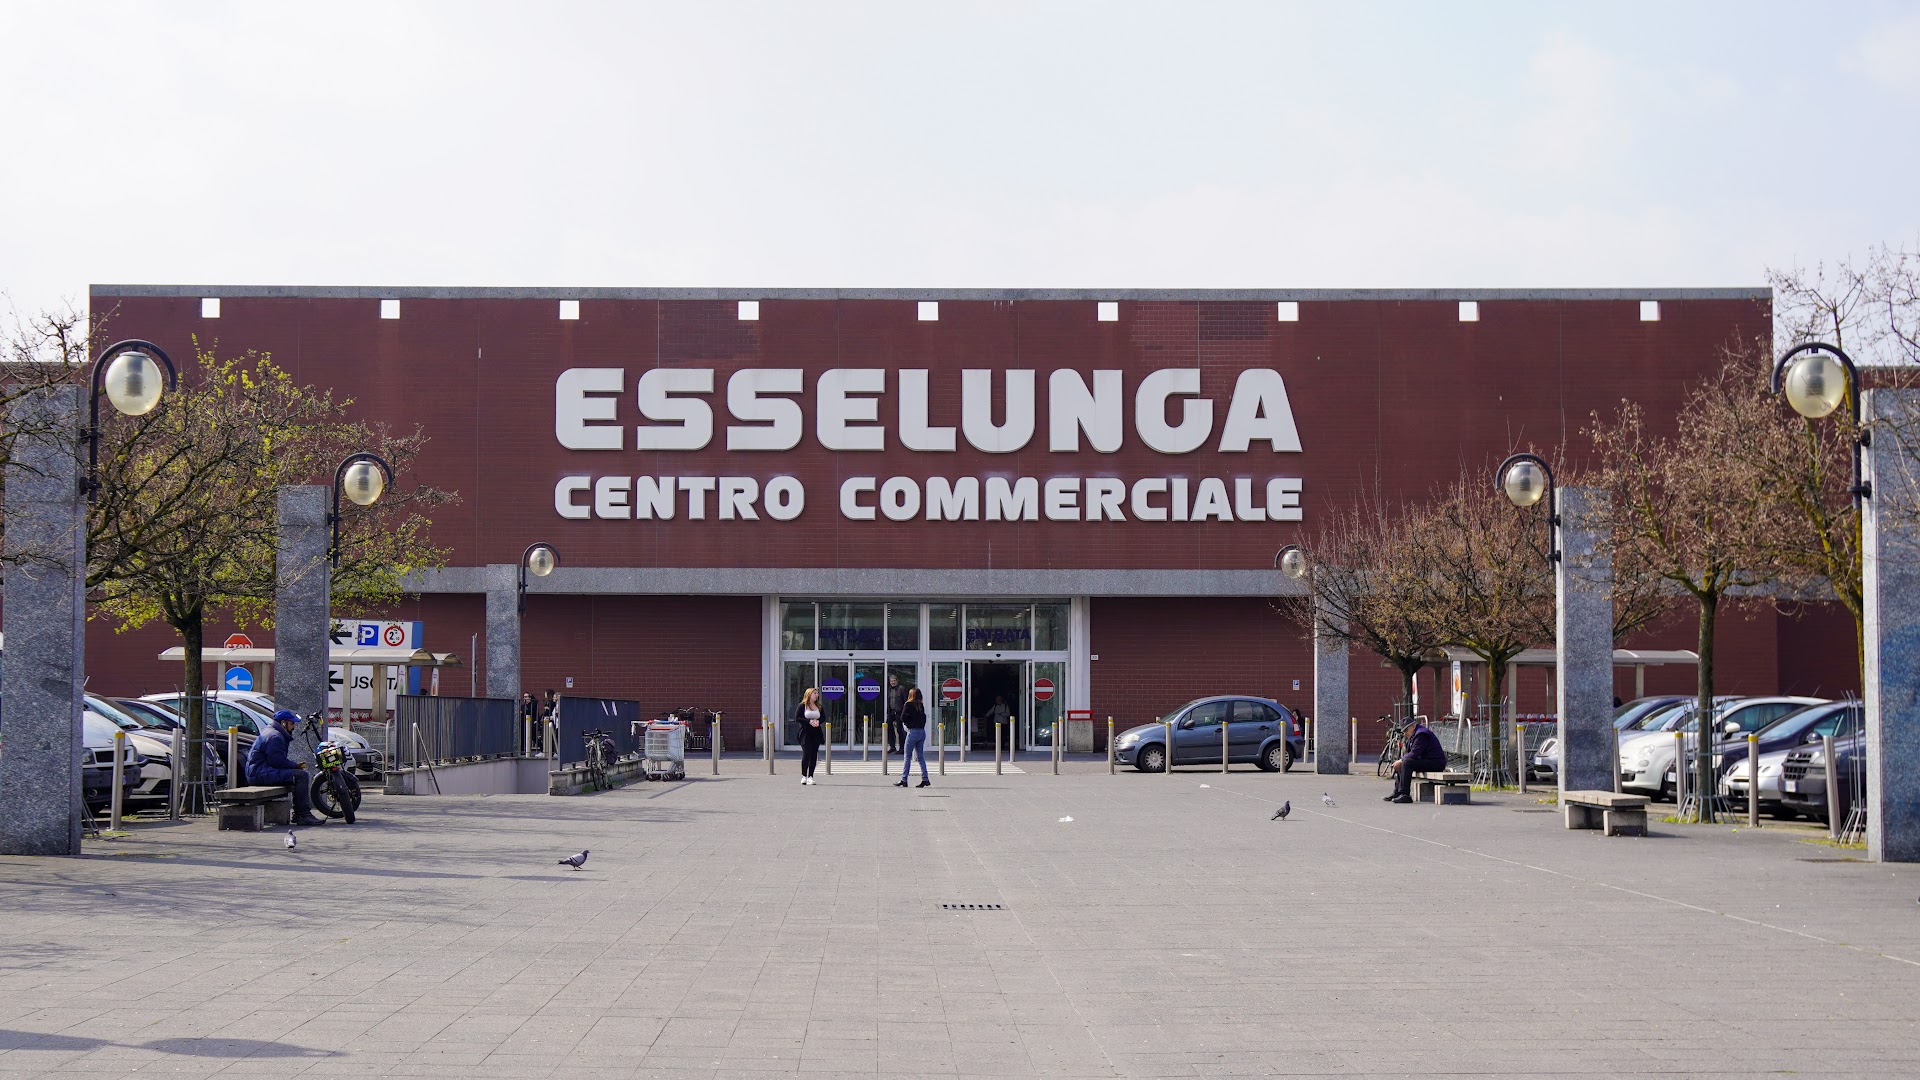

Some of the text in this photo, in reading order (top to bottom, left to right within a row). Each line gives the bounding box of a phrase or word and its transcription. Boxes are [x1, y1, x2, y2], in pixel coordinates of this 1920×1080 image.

[555, 368, 1303, 454] ESSELUNGA
[555, 476, 1303, 522] CENTRO COMMERCIALE
[361, 627, 375, 644] P
[966, 629, 1030, 640] ENTRATA
